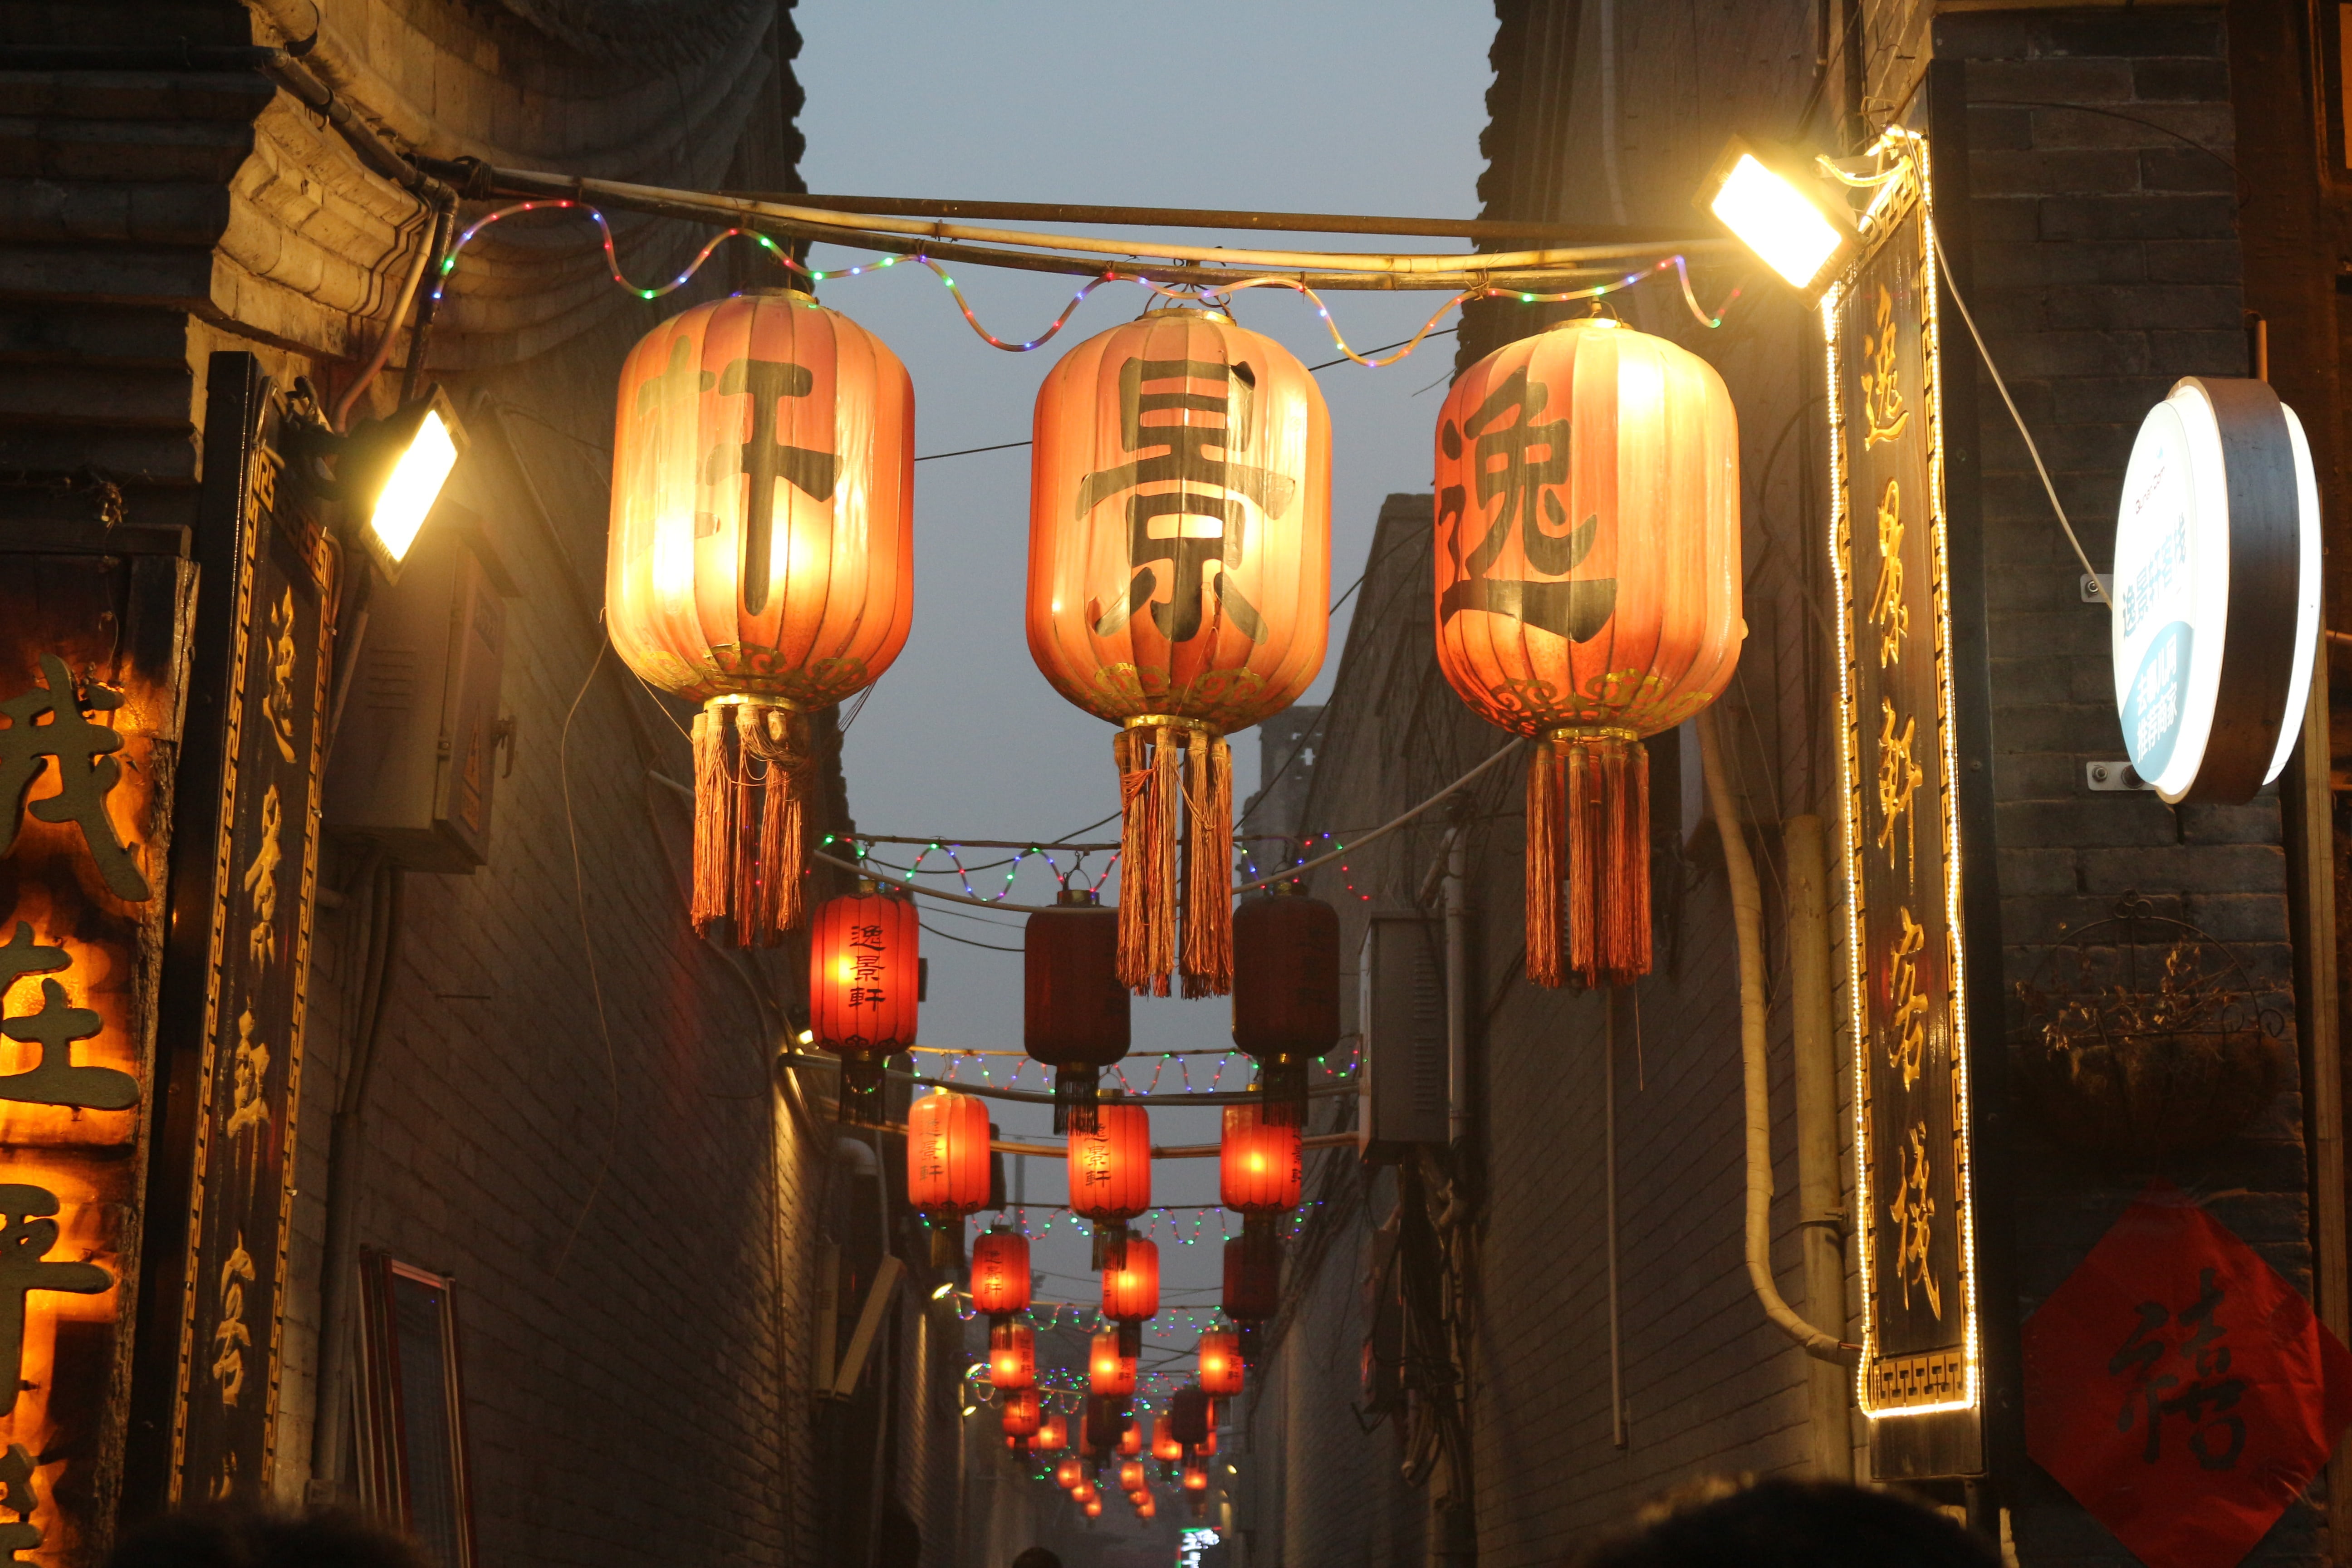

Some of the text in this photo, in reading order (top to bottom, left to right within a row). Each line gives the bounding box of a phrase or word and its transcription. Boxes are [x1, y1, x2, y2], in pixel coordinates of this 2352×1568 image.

[1076, 358, 1296, 647] 景
[1437, 367, 1617, 644] 逸
[2136, 633, 2177, 717] 去哪儿网
[2136, 681, 2178, 764] 推荐商家
[848, 925, 887, 1012] 逸景軒
